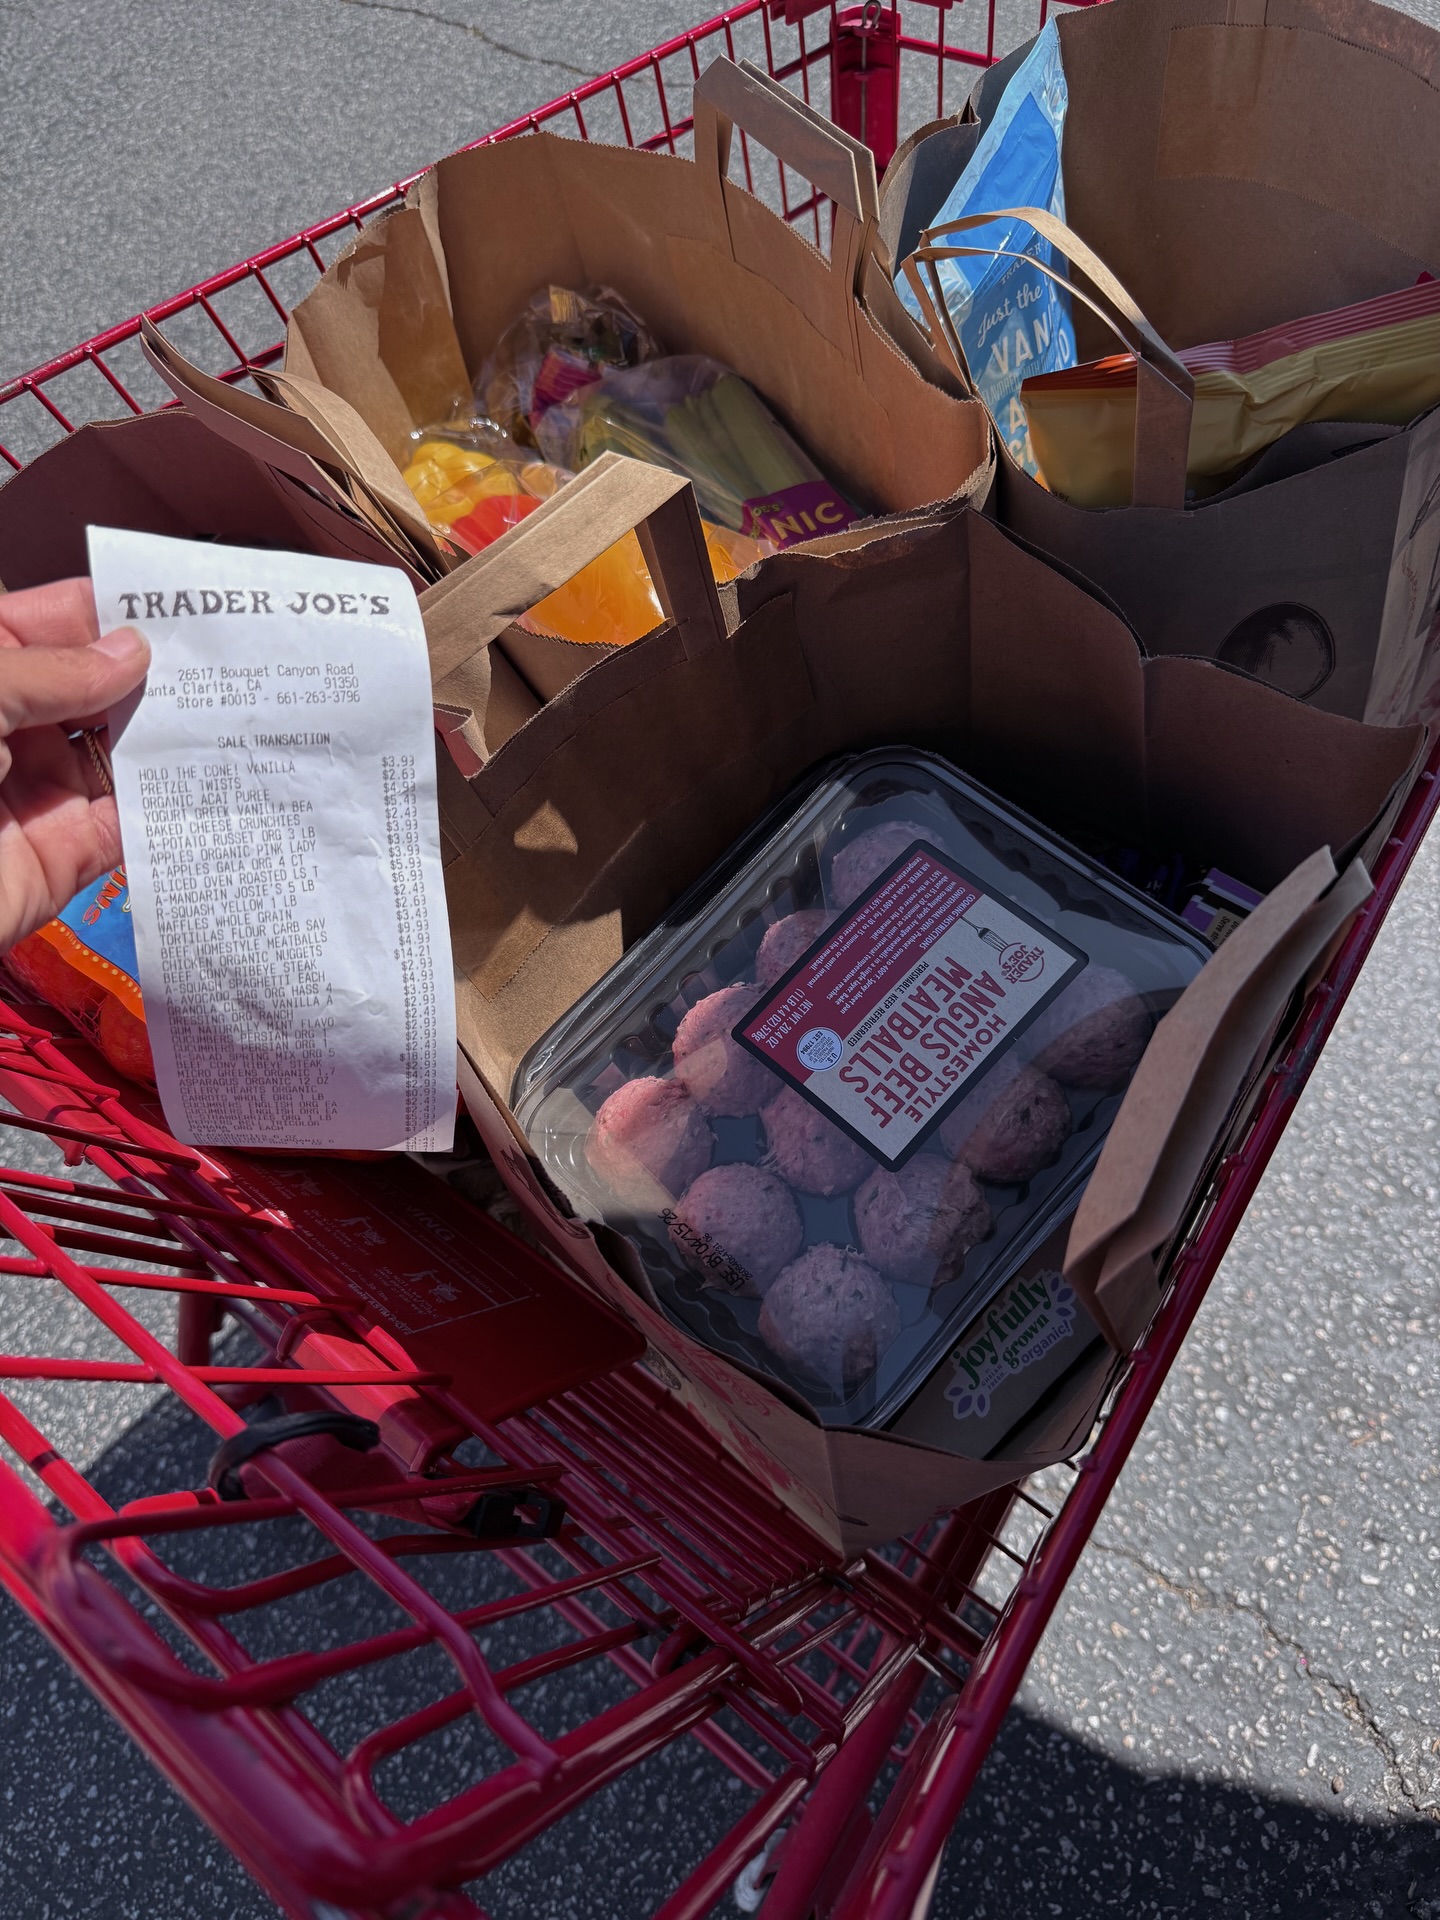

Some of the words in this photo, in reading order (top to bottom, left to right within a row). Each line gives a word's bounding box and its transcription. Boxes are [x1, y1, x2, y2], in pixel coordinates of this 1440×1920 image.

[977, 297, 1014, 348] Just
[1016, 283, 1044, 309] the
[118, 589, 274, 620] TRADER
[287, 591, 390, 616] JOE'S
[178, 668, 213, 682] 26517
[221, 664, 270, 680] Bouquet
[278, 664, 320, 679] Canyon
[326, 663, 355, 676] Road
[183, 680, 239, 695] Clarita,
[247, 679, 262, 692] CA
[324, 676, 359, 690] 91350
[177, 696, 213, 709] Store
[220, 693, 256, 707] #0013
[277, 689, 360, 704] 661-263-3796
[218, 735, 247, 749] SALE
[254, 732, 331, 747] TRANSACTION
[139, 768, 169, 781] HOLD
[177, 766, 197, 779] THE
[204, 764, 239, 778] CONE!
[246, 761, 296, 776] VANILLA
[141, 780, 192, 795] PRETZEL
[142, 794, 193, 809] ORGANIC
[200, 791, 229, 805] ACAI
[235, 788, 271, 802] PUREE
[144, 808, 187, 823] YOGURT
[195, 805, 230, 819] GREEK
[237, 801, 285, 816] VANILLA
[292, 799, 313, 812] BEA
[146, 822, 183, 837] BAKED
[189, 819, 232, 834] CHEESE
[239, 813, 301, 830] CRUNCHIES
[213, 831, 254, 846] RUSSET
[262, 828, 282, 842] ORG
[288, 827, 295, 840] 3
[302, 826, 316, 838] LB
[150, 849, 194, 865] APPLES
[201, 845, 250, 861] ORGANIC
[257, 842, 283, 856] PINK
[290, 839, 317, 853] LADY
[152, 862, 210, 879] A-APPLES
[216, 859, 245, 873] GALA
[251, 856, 273, 870] ORG
[278, 855, 285, 867] 4
[291, 853, 305, 866] CT
[153, 877, 197, 893] SLICED
[204, 873, 233, 888] OVEN
[239, 868, 287, 884] ROASTED
[934, 876, 948, 889] about
[945, 881, 957, 892] with
[155, 887, 227, 906] A-MANDARIN
[234, 882, 282, 898] JOSIE'S
[288, 881, 295, 893] 5
[302, 879, 315, 892] LB
[927, 891, 946, 908] cooking
[157, 902, 214, 919] R-SQUASH
[221, 897, 264, 913] YELLOW
[284, 894, 297, 907] LB
[902, 904, 920, 921] minutes
[932, 887, 965, 919] CONVENTIONAL
[952, 894, 975, 917] COOKING
[158, 916, 208, 932] WAFFLES
[215, 912, 251, 927] WHOLE
[257, 908, 293, 923] GRAIN
[916, 907, 930, 920] spray.
[160, 927, 224, 946] TORTILLAS
[231, 923, 266, 938] FLOUR
[273, 919, 300, 933] CARB
[306, 916, 326, 930] SAV
[886, 926, 898, 939] until
[900, 919, 919, 937] Arrange
[919, 918, 934, 932] OVEN:
[920, 915, 955, 949] INSTRUCTIONS
[161, 944, 190, 959] BEEF
[196, 937, 260, 956] HOMESTYLE
[267, 930, 327, 948] MEATBALLS
[869, 937, 888, 956] internal
[879, 937, 901, 959] meatballs
[902, 931, 922, 949] Preheat
[162, 956, 213, 971] CHICKEN
[219, 950, 269, 966] ORGANIC
[275, 945, 322, 960] NUGGETS
[394, 945, 431, 968] $14.21
[892, 948, 904, 960] oven
[164, 970, 192, 983] BEEF
[234, 962, 276, 977] RIBEYE
[283, 959, 317, 972] STEAK
[843, 955, 871, 983] temperature
[858, 967, 872, 981] single
[895, 961, 929, 994] PERISHABLE,
[228, 974, 290, 989] SPAGHETTI
[298, 971, 325, 984] EACH
[846, 980, 861, 993] layer.
[861, 978, 876, 992] Spray
[827, 982, 844, 1000] reaches
[835, 993, 849, 1005] Bake
[849, 991, 863, 1005] sheet
[884, 993, 899, 1009] KEEP
[777, 1005, 790, 1017] 4.4
[798, 999, 813, 1015] NET
[840, 1003, 851, 1014] pan
[921, 972, 1005, 1059] ANGUS
[767, 1014, 781, 1027] OZ)
[787, 1012, 803, 1025] WT.
[840, 958, 971, 1092] MEATBALLS
[848, 1007, 885, 1047] REFRIGERATED
[751, 1025, 772, 1042] 578g
[775, 1022, 792, 1039] 20.4
[766, 1036, 779, 1048] OZ
[826, 1053, 838, 1063] U.S.
[906, 1015, 1006, 1122] HOMESTYLE
[866, 1054, 932, 1127] BEEF
[658, 1208, 708, 1255] 04/15/26
[703, 1251, 723, 1269] BY
[720, 1265, 745, 1290] USE
[952, 1275, 1052, 1390] joyfully
[1002, 1313, 1050, 1369] grown
[1021, 1319, 1071, 1364] organic!
